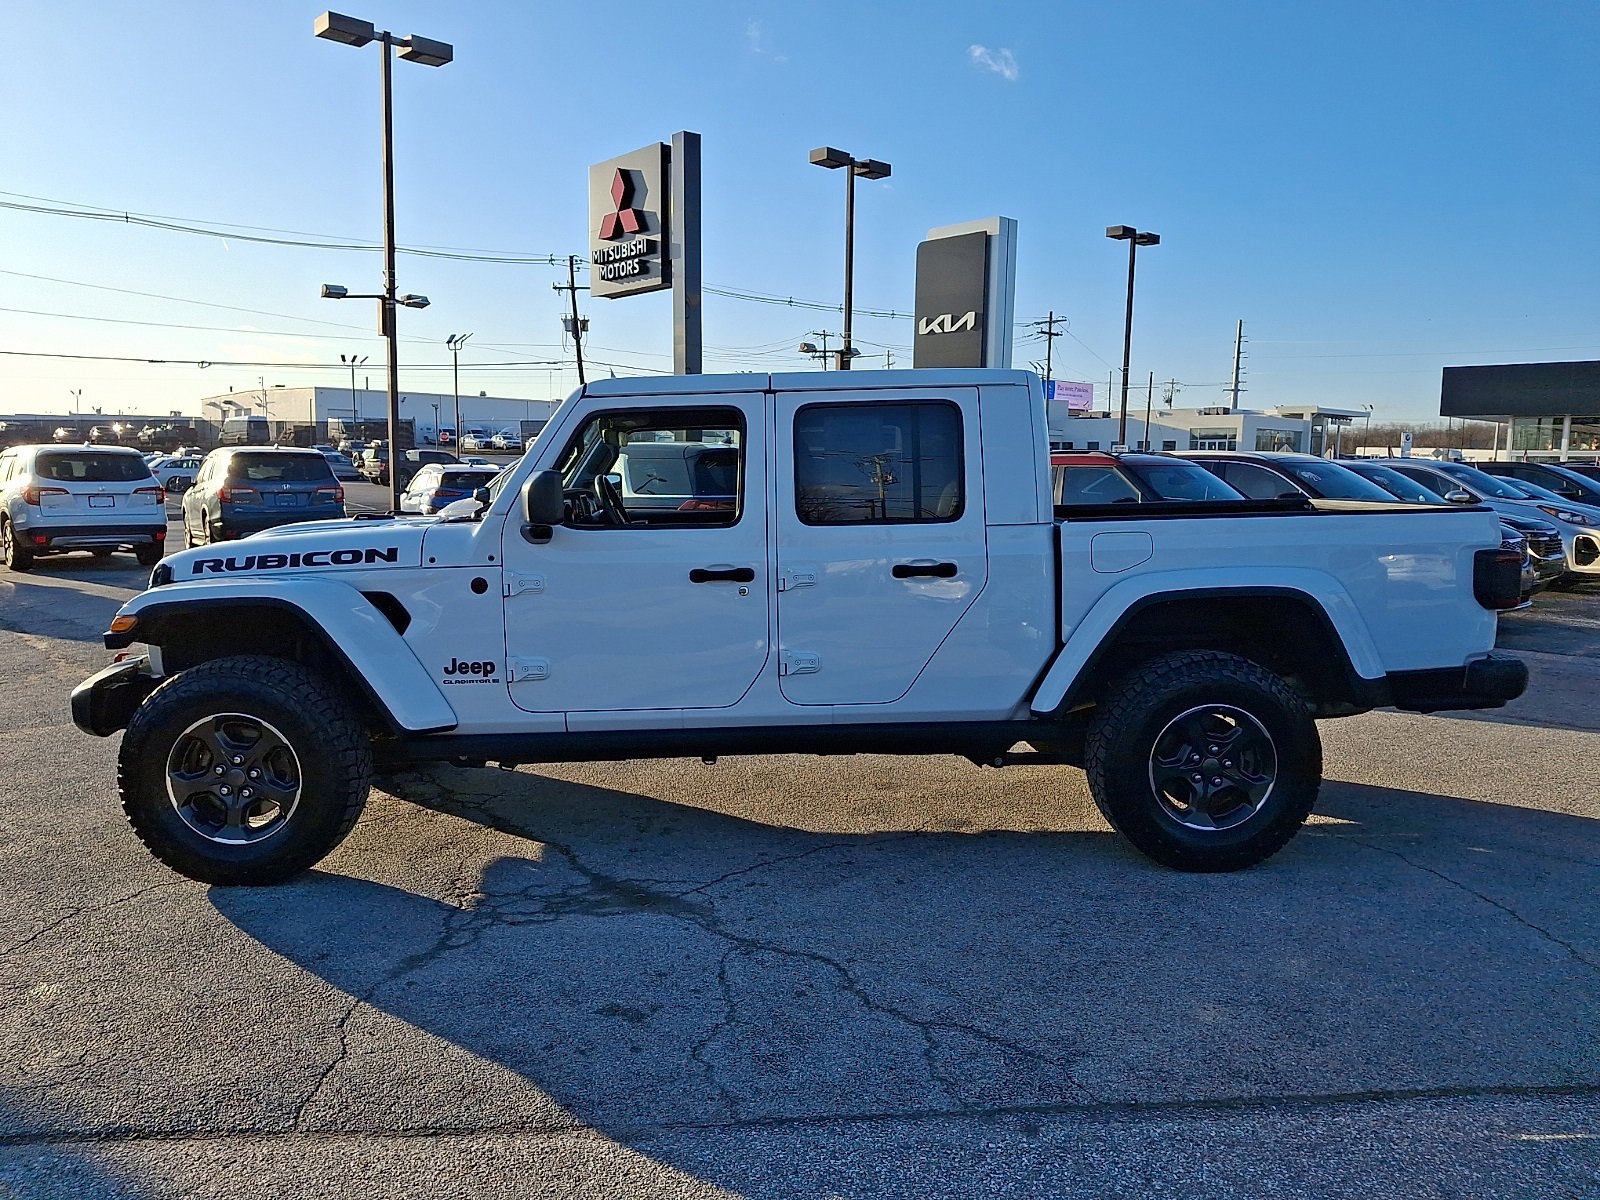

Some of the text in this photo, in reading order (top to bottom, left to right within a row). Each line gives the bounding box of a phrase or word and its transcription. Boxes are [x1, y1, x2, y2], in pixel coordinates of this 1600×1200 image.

[592, 238, 647, 261] MITSUBISHI
[599, 259, 640, 279] MOTORS
[918, 311, 976, 335] KIA
[192, 547, 399, 574] RUBICON
[443, 657, 496, 677] Jeep
